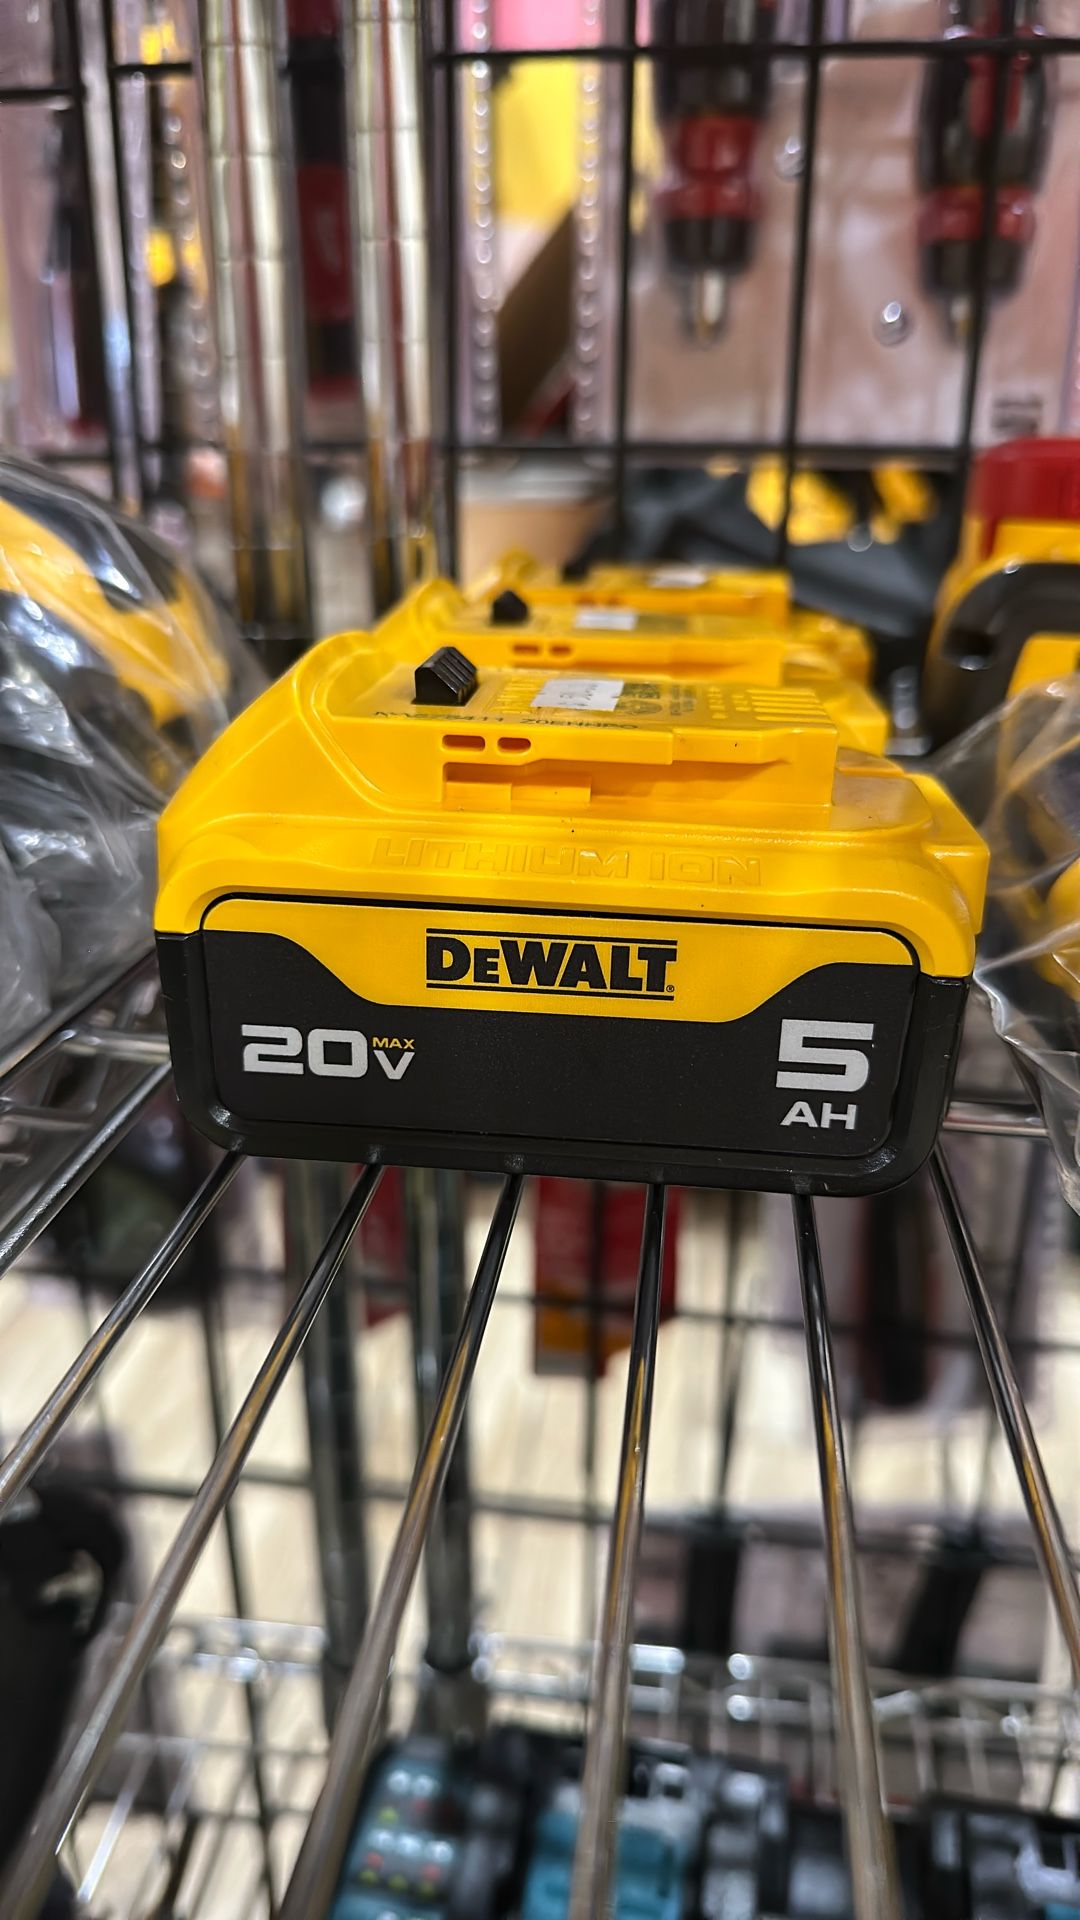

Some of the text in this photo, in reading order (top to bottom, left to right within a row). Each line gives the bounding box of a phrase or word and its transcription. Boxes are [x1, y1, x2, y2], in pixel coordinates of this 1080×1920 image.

[371, 836, 761, 886] LITHIUM ION
[372, 1036, 415, 1050] MAX
[775, 1018, 875, 1093] 5
[780, 1100, 858, 1130] AH
